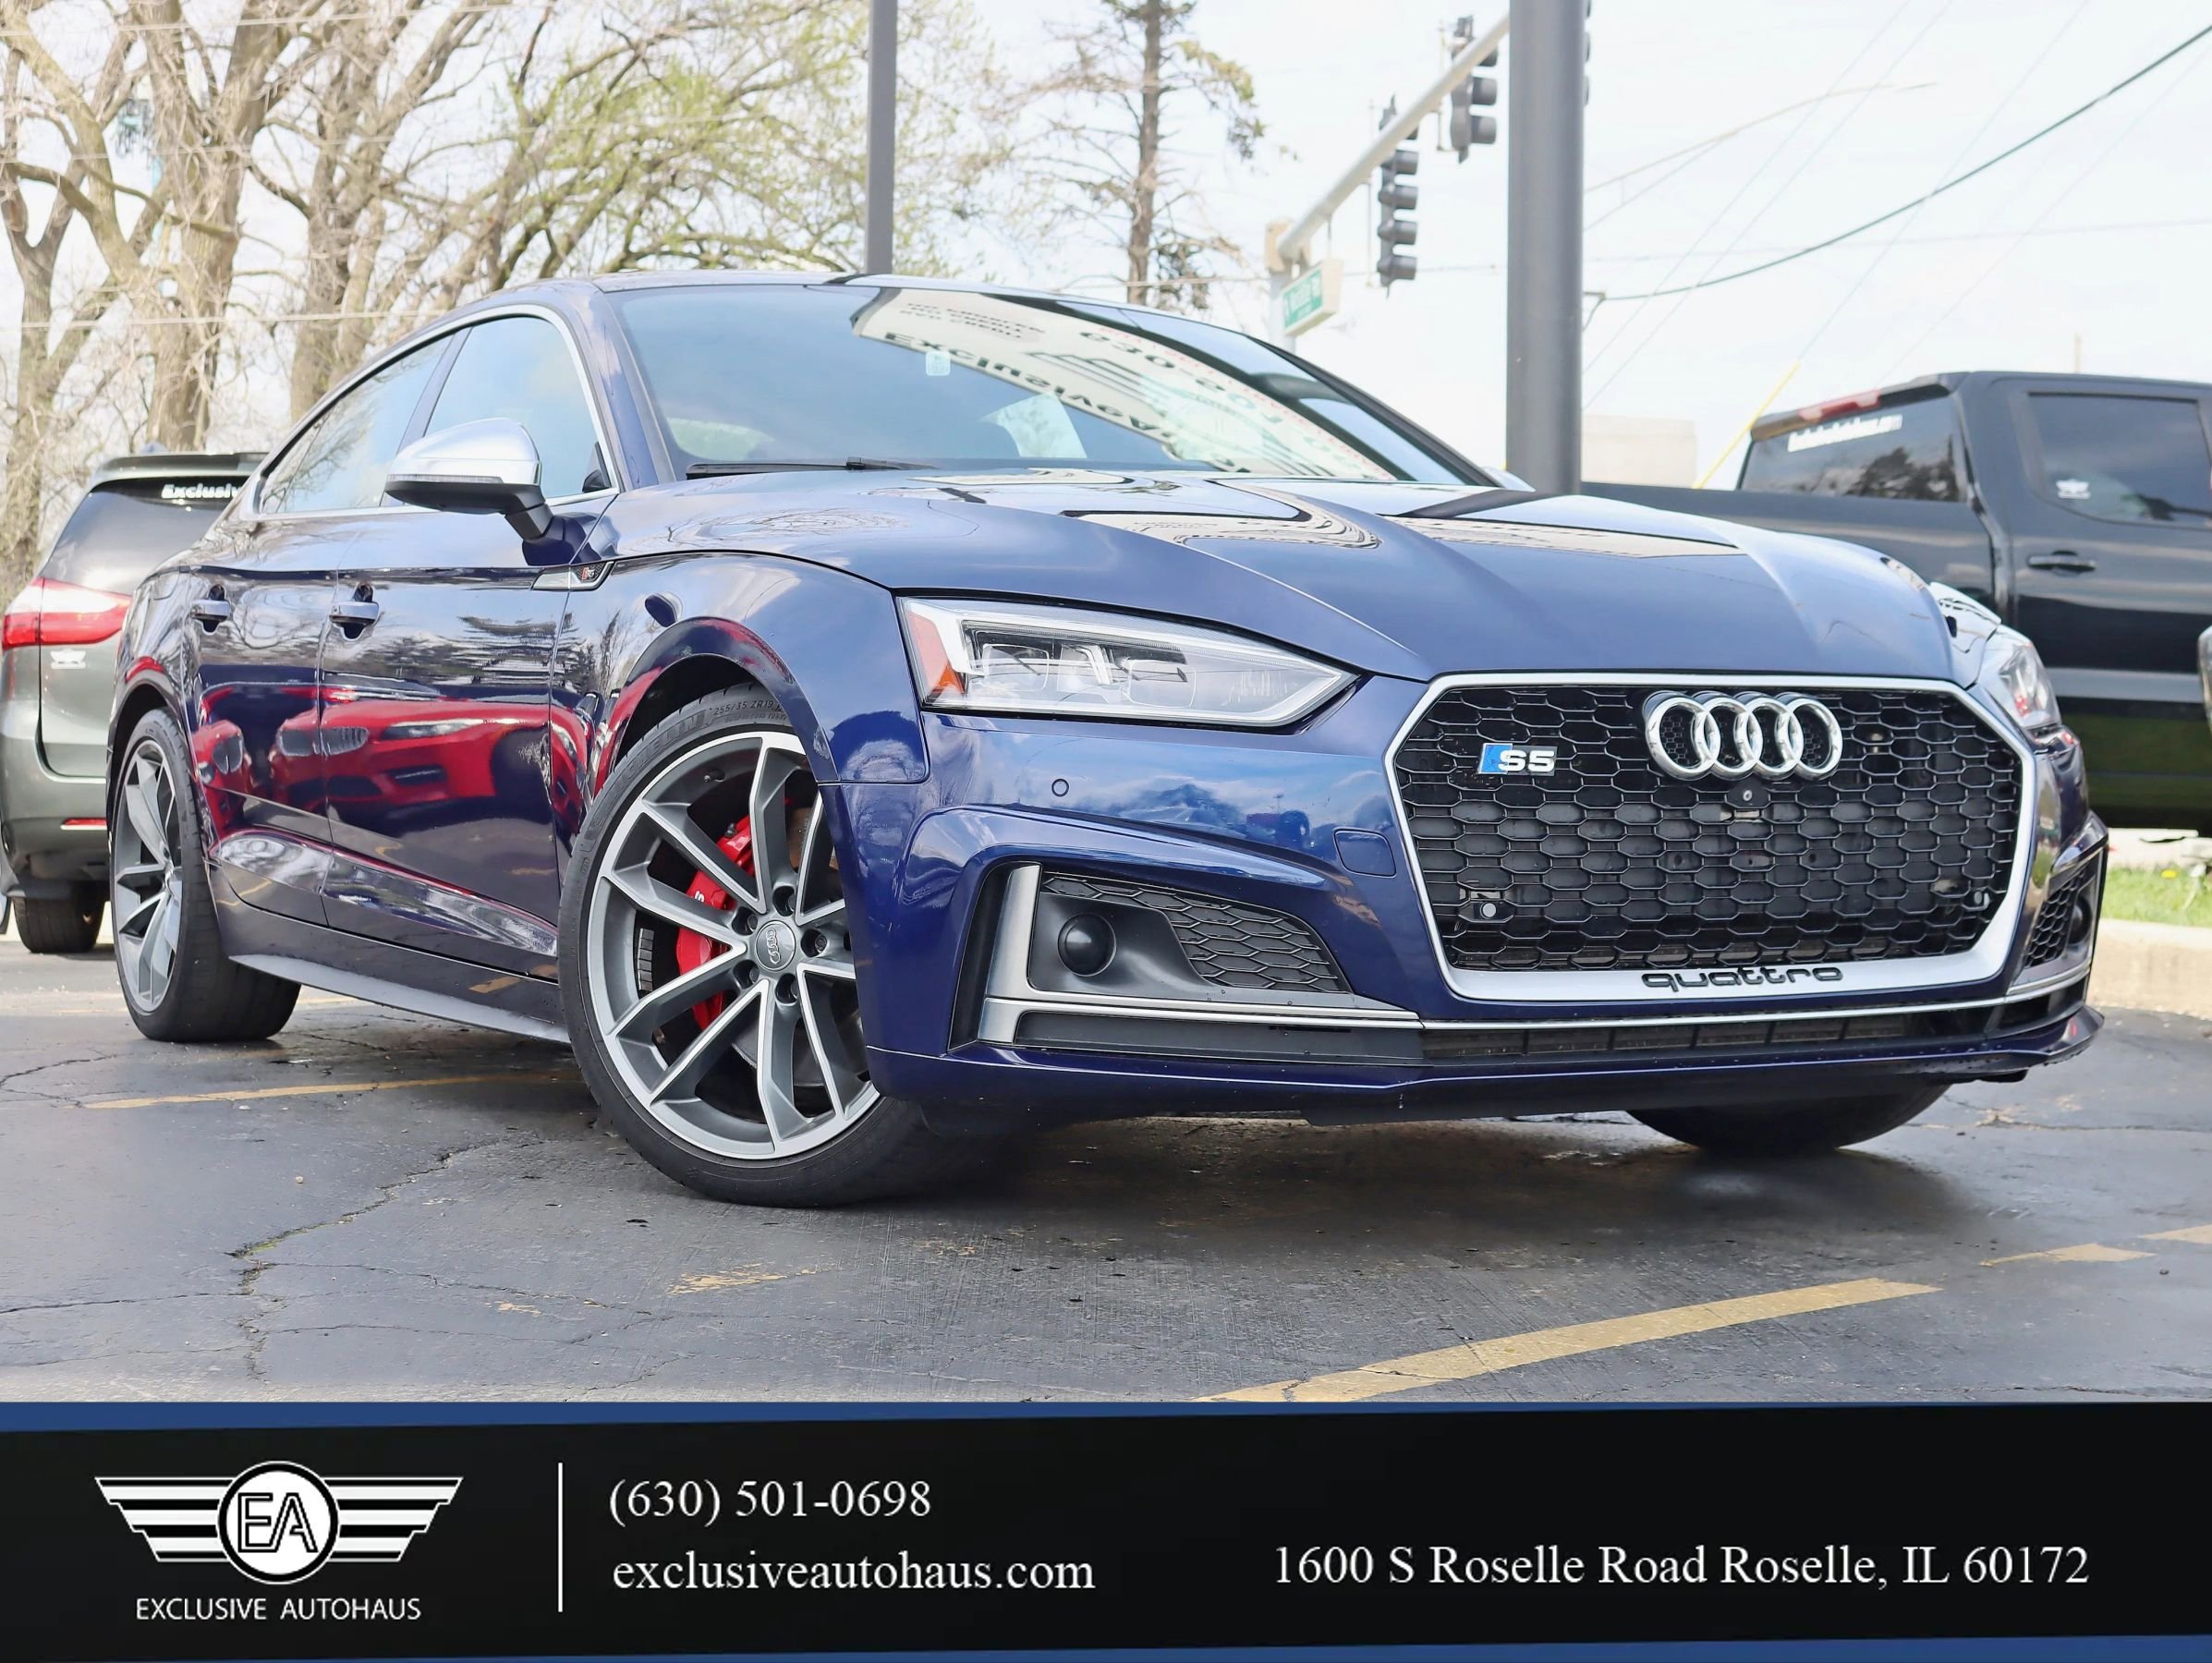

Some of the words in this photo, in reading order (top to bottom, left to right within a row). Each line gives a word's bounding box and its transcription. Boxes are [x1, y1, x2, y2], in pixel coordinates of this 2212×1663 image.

[713, 701, 747, 715] 255/35
[1498, 749, 1556, 772] S5
[1641, 966, 1844, 992] quattro
